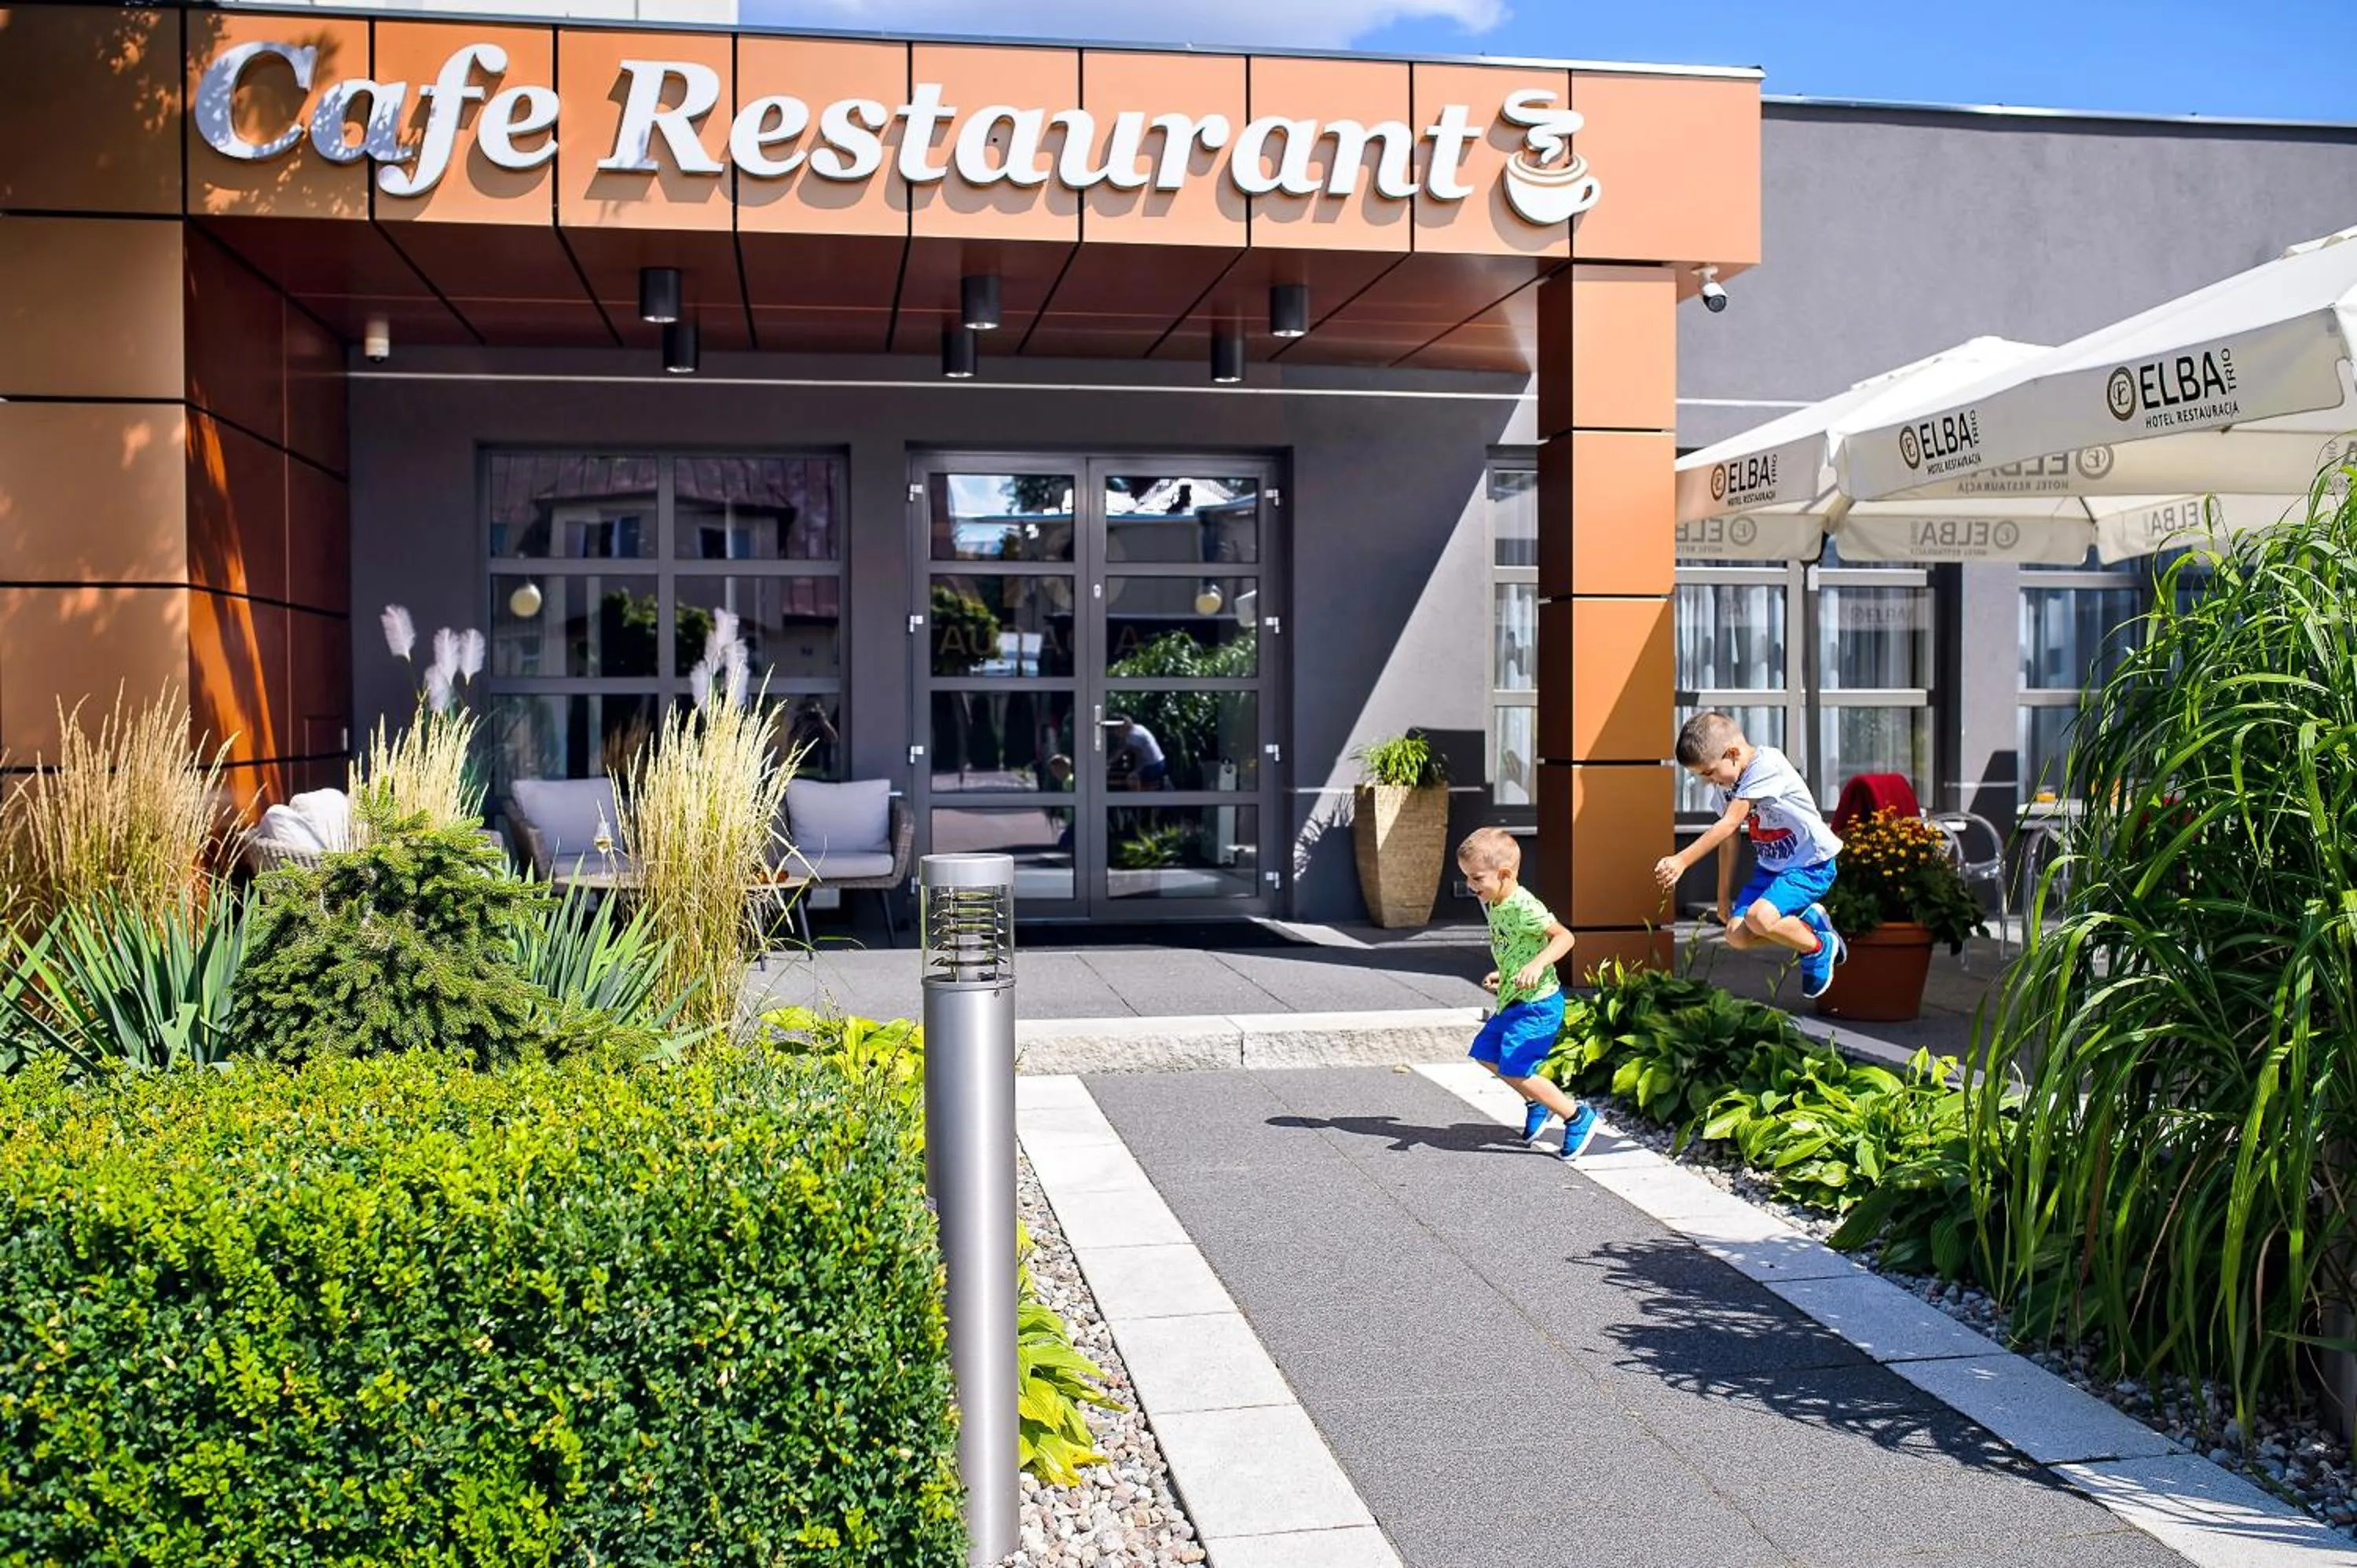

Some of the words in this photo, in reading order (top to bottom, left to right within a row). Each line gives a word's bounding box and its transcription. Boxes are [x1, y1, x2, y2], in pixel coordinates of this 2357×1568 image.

[194, 40, 560, 198] Cafe
[595, 58, 1483, 202] Restaurant
[2139, 351, 2227, 410] ELBA
[2220, 348, 2237, 391] TRIO
[1919, 412, 1973, 460] ELBA
[2146, 412, 2175, 428] HOTEL
[2177, 400, 2240, 423] RESTAURACJA
[1728, 455, 1771, 493] ELBA
